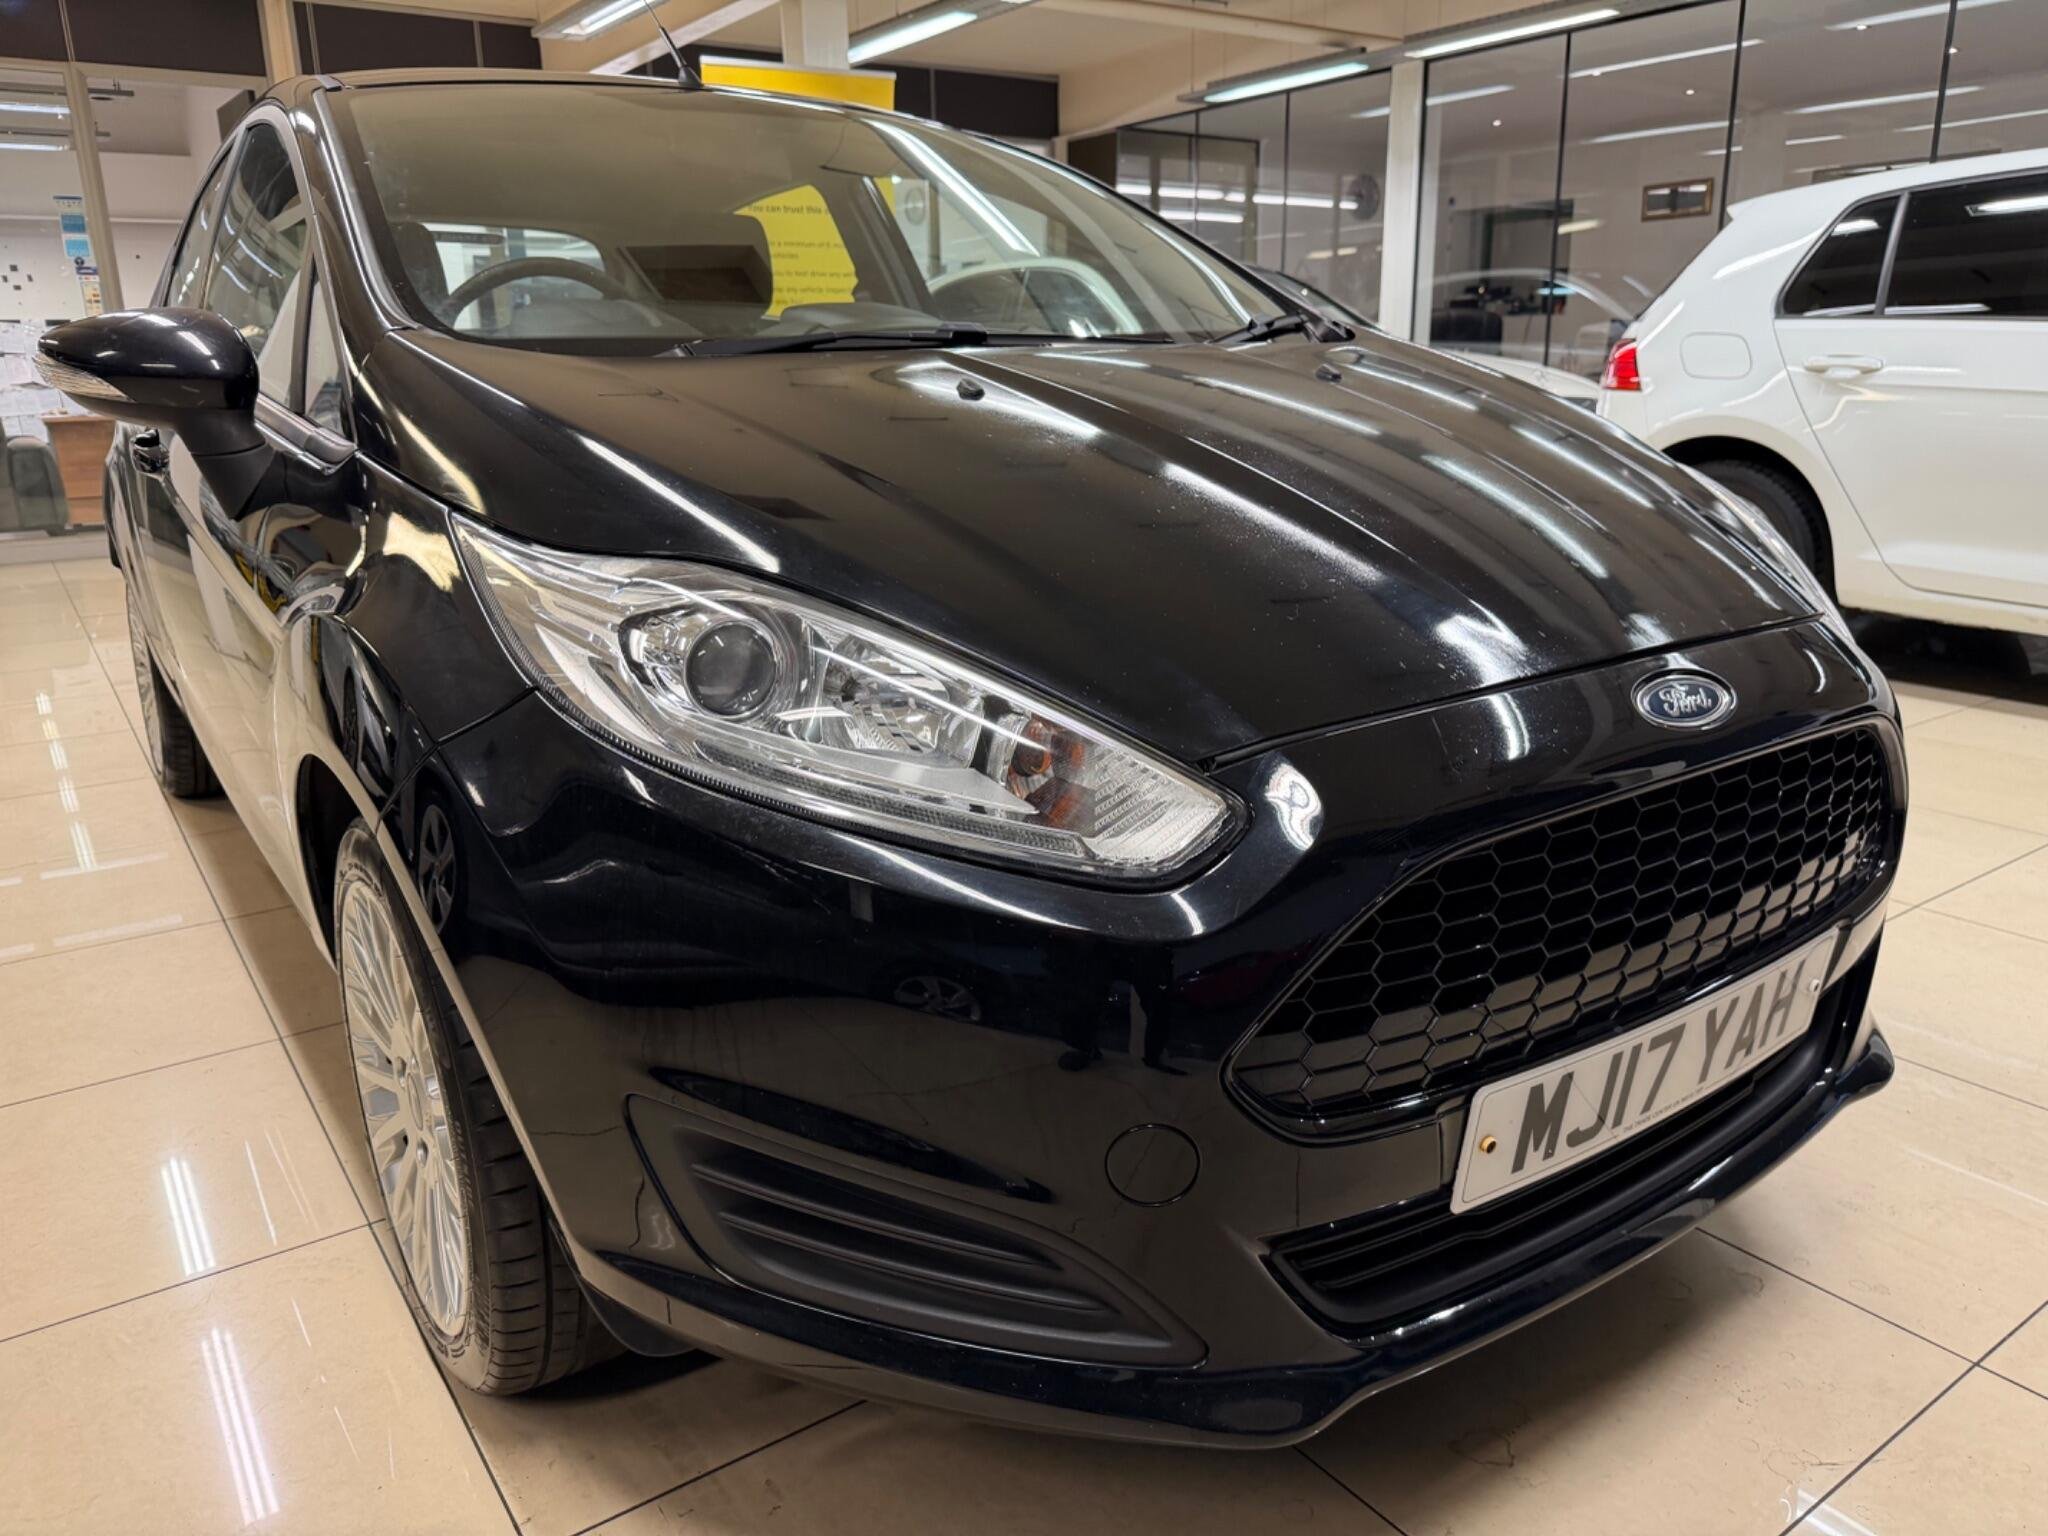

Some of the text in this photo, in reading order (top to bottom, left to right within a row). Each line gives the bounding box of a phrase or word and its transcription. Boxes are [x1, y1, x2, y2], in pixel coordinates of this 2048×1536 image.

[766, 205, 781, 213] can
[783, 204, 804, 214] trust
[806, 205, 822, 214] this
[1658, 682, 1712, 717] Ford
[1510, 959, 1806, 1175] MJ17 YAH
